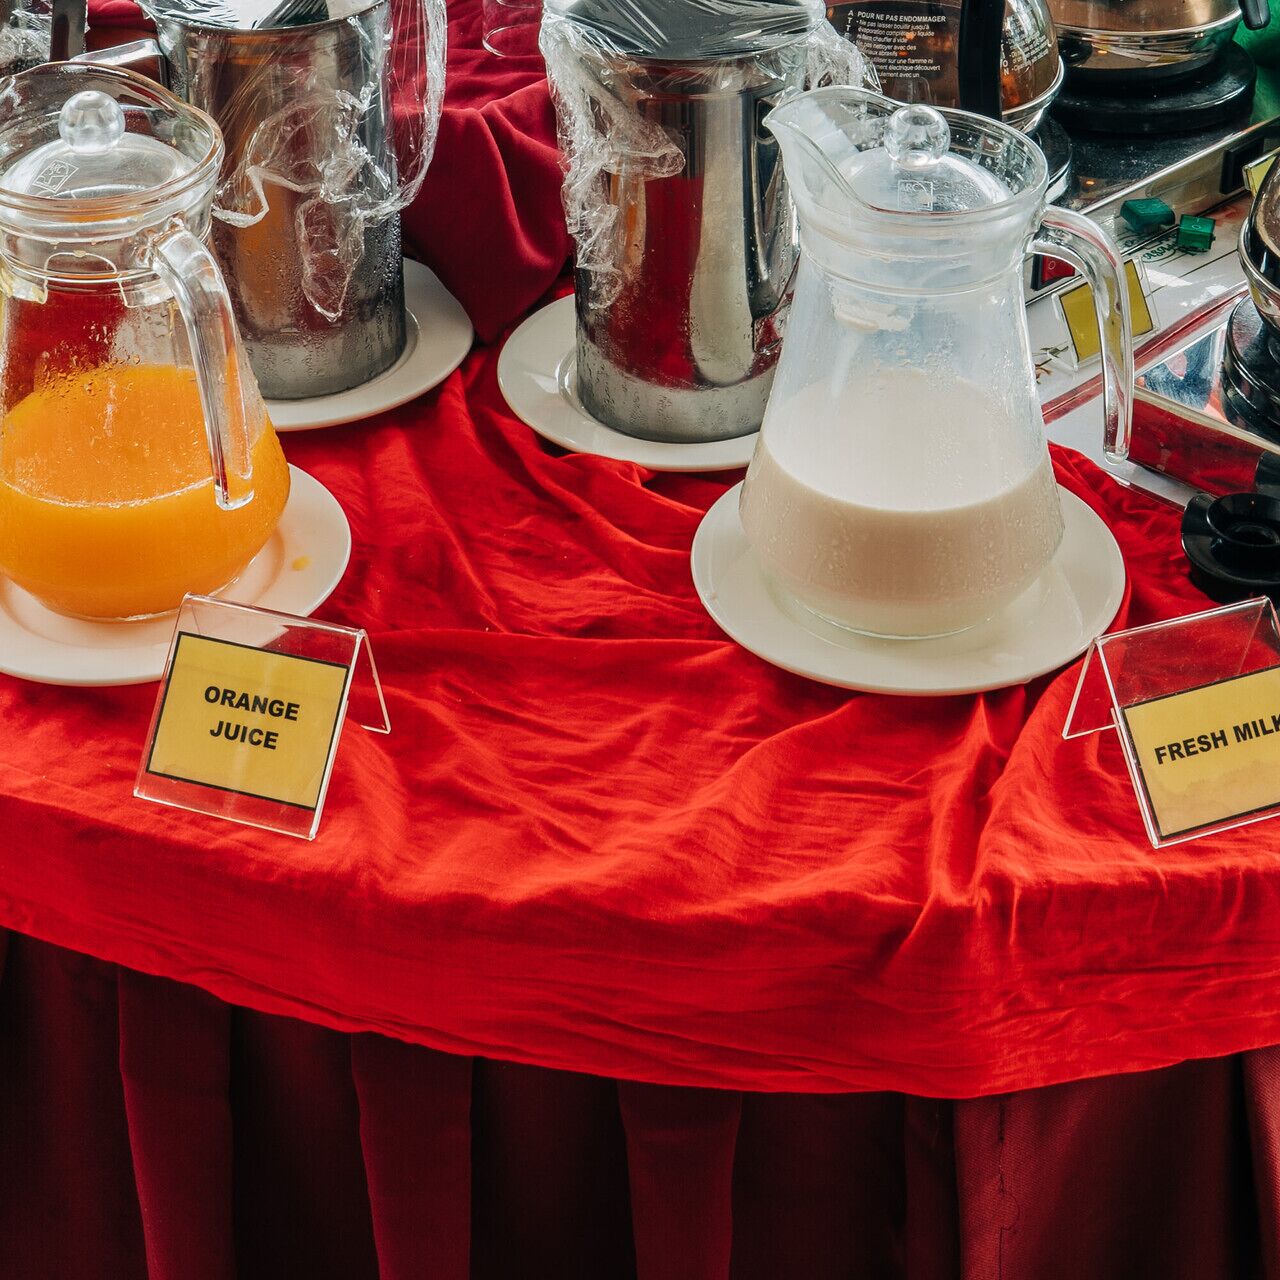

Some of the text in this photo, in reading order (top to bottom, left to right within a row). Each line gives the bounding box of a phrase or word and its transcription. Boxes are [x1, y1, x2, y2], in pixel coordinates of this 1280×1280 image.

[857, 11, 875, 20] POUR
[204, 685, 300, 721] ORANGE
[209, 720, 279, 750] JUICE
[1154, 729, 1229, 765] FRESH
